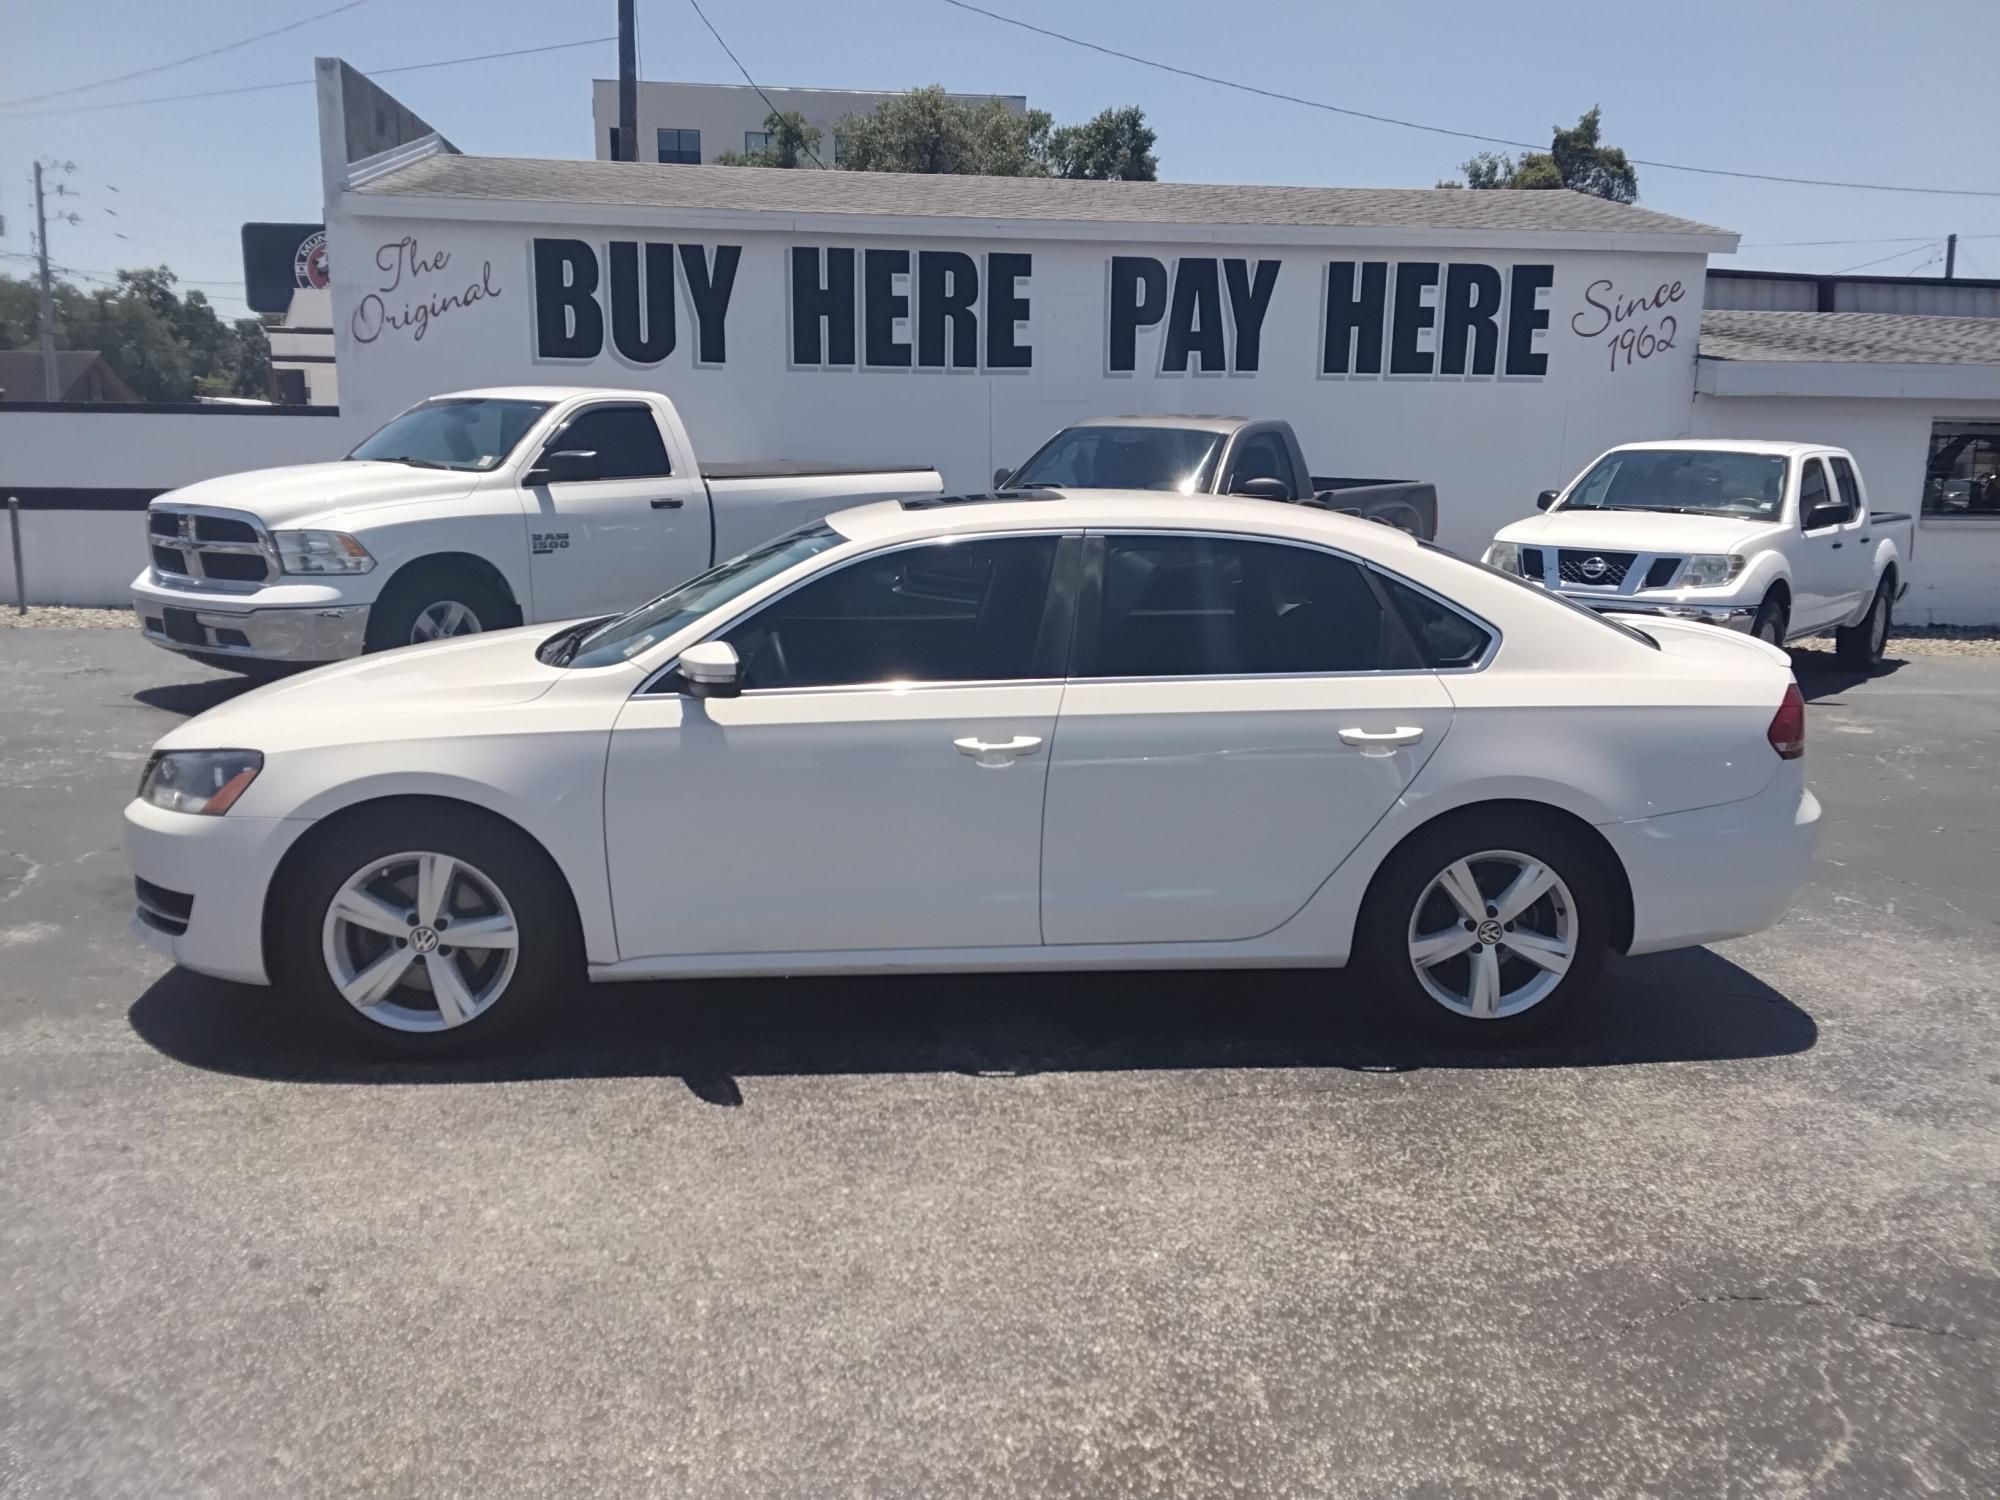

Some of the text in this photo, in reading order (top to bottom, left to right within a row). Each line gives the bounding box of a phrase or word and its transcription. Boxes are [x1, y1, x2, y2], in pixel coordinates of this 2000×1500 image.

[375, 235, 451, 292] The
[351, 260, 502, 344] Original
[531, 237, 1555, 377] BUY HERE PAY HERE
[1571, 279, 1686, 338] Since
[1607, 315, 1677, 372] 1962
[532, 533, 569, 541] RAM
[532, 540, 570, 549] 1500
